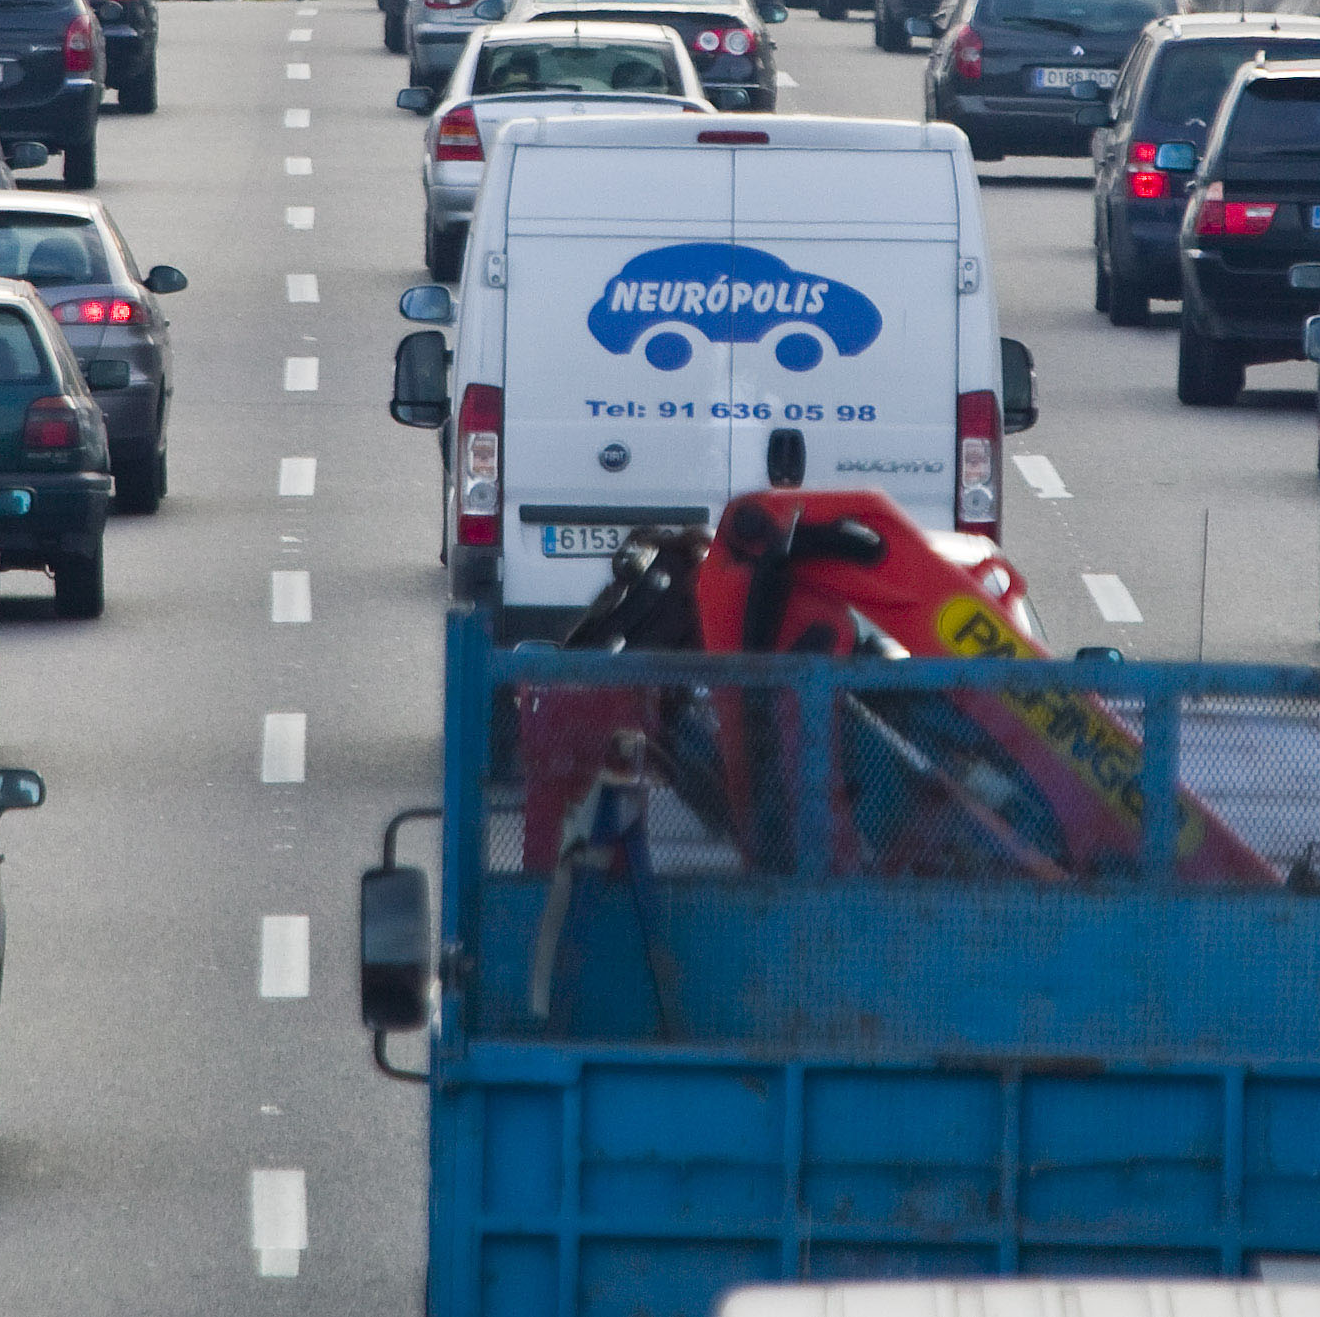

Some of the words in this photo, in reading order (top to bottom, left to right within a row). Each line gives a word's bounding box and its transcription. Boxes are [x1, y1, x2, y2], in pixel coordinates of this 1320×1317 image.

[612, 275, 829, 315] NEURÓPOLIS
[585, 399, 647, 419] Tel:
[658, 401, 695, 419] 91
[710, 402, 772, 421] 636
[784, 404, 825, 422] 05
[836, 405, 877, 423] 98
[560, 527, 619, 551] 6153
